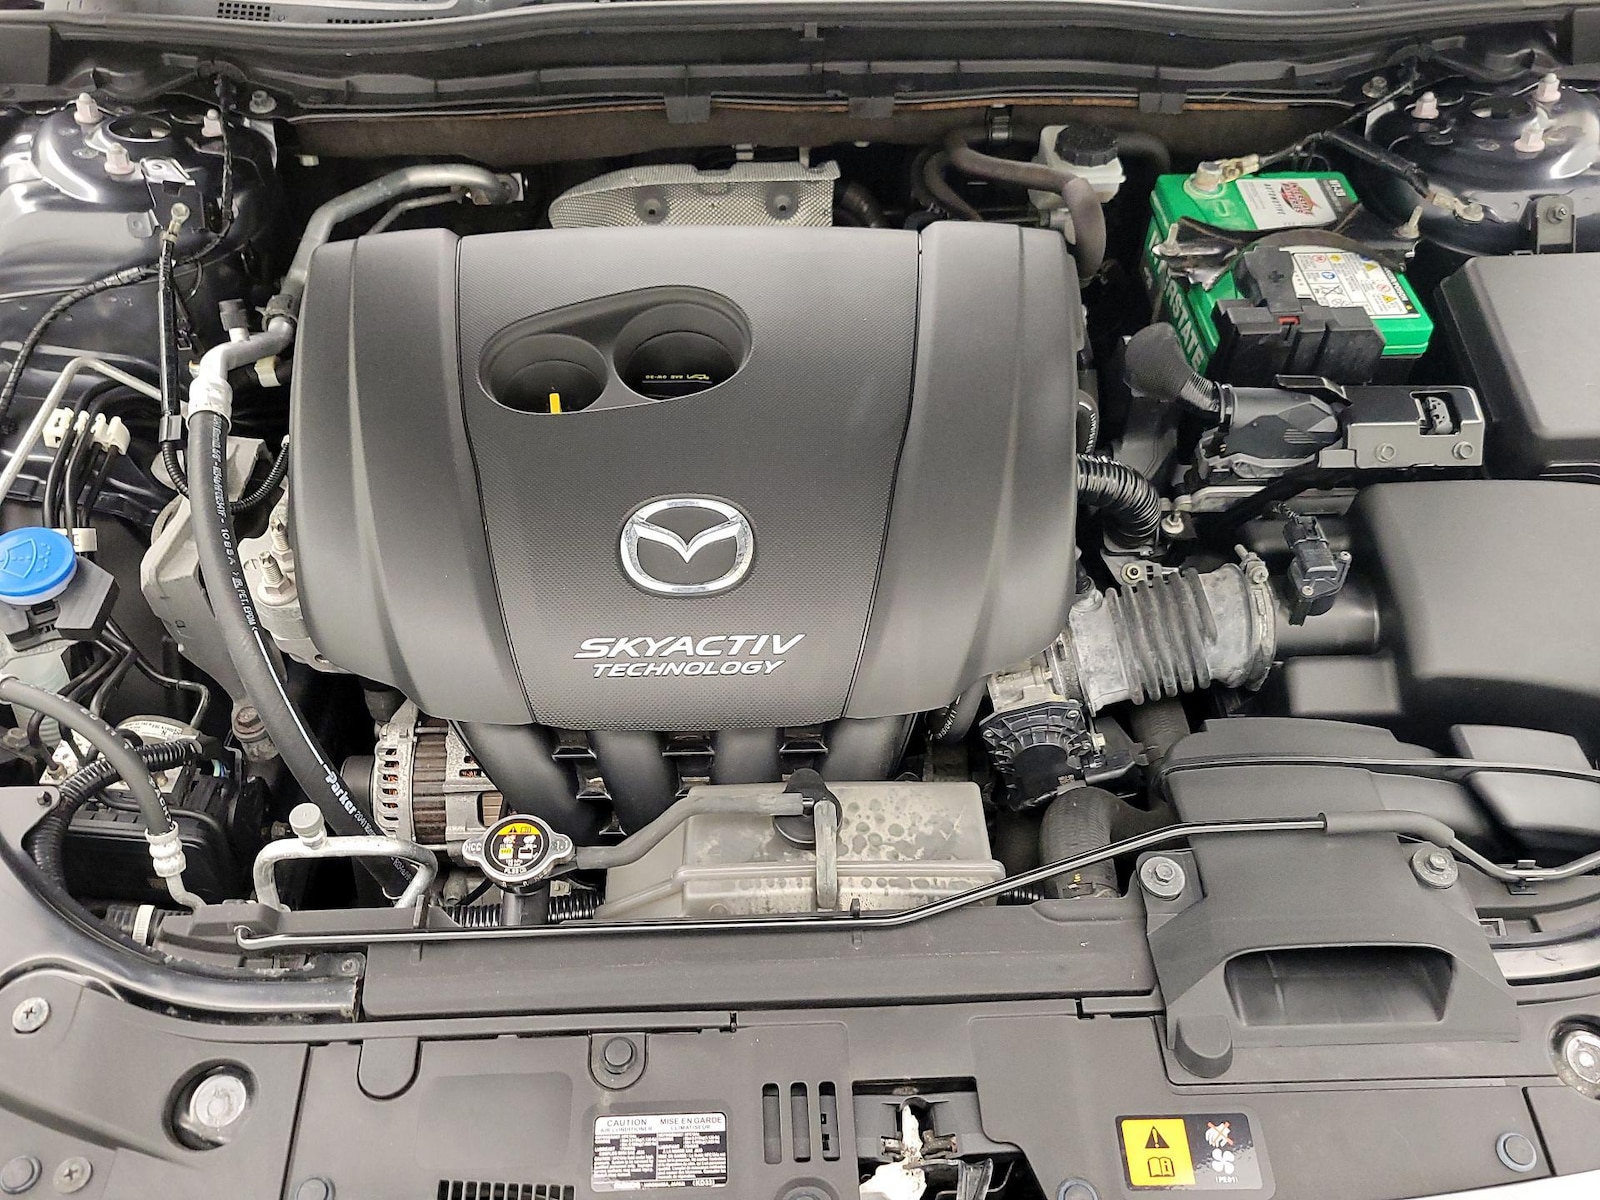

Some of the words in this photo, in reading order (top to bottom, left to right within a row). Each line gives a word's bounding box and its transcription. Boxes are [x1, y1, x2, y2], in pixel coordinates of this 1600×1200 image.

[573, 634, 806, 659] SKYACTIV
[593, 660, 786, 678] TECHNOLOGY
[325, 771, 357, 815] Parker
[607, 1119, 648, 1127] CAUTION
[660, 1117, 679, 1125] MISE
[694, 1116, 722, 1124] GARDE
